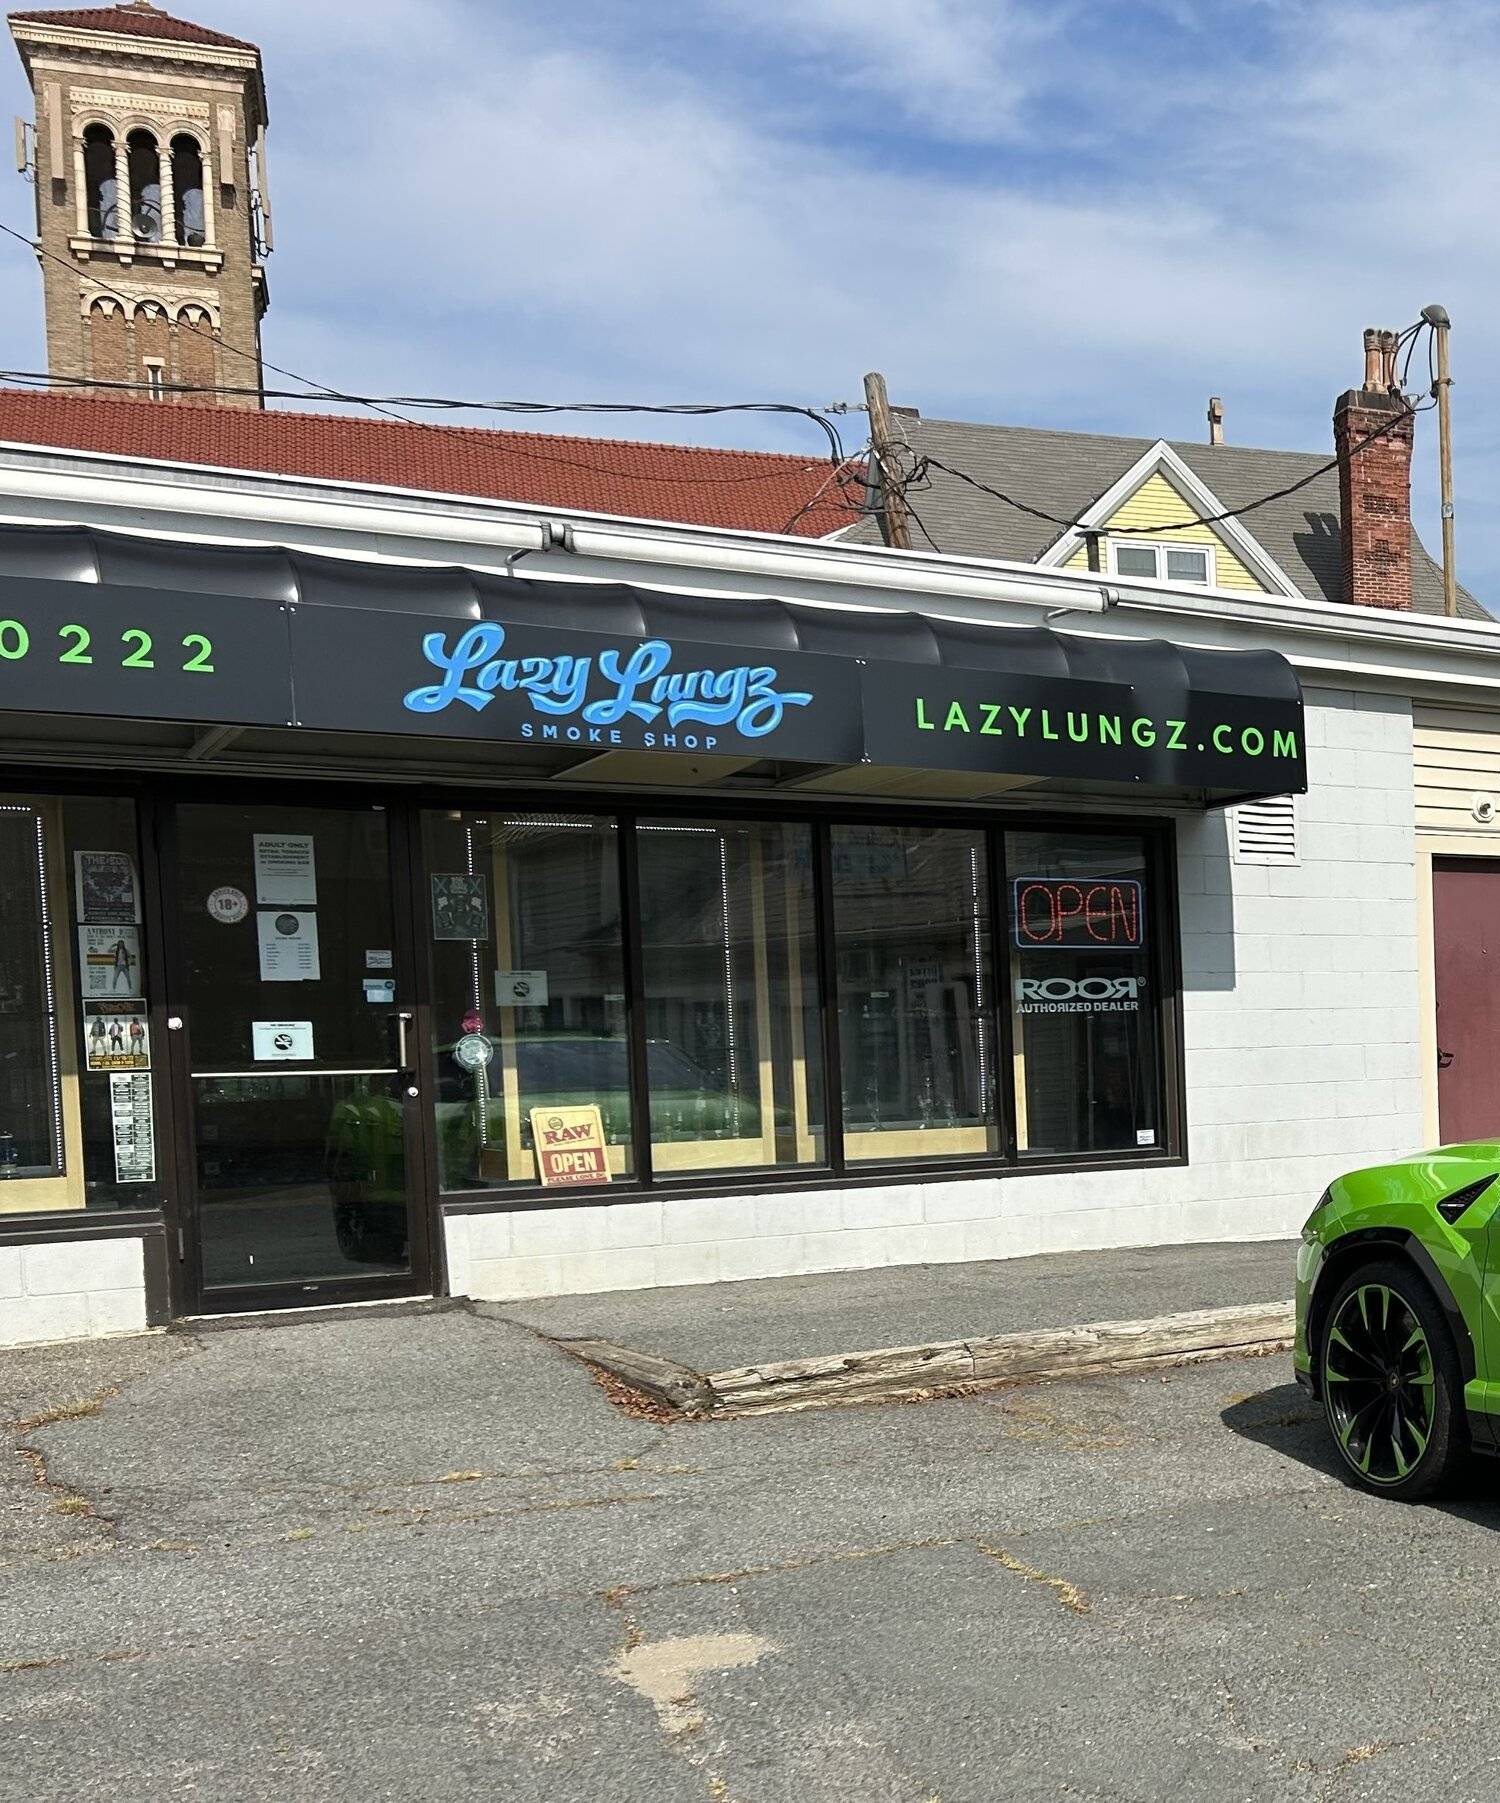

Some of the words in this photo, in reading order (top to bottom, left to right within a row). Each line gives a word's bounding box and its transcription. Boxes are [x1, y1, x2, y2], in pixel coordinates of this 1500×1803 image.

[403, 622, 592, 716] Lazy
[582, 637, 814, 738] Lungz
[521, 723, 622, 744] SMOKE
[644, 732, 718, 749] SHOP
[916, 698, 1298, 759] LAZYLUNGZ.COM
[218, 899, 239, 910] 18+
[1021, 885, 1137, 942] OPEN
[1016, 1002, 1092, 1013] AUTHORIZED
[1094, 1001, 1139, 1012] DEALER
[543, 1123, 594, 1144] RAW
[550, 1151, 598, 1174] OPEN
